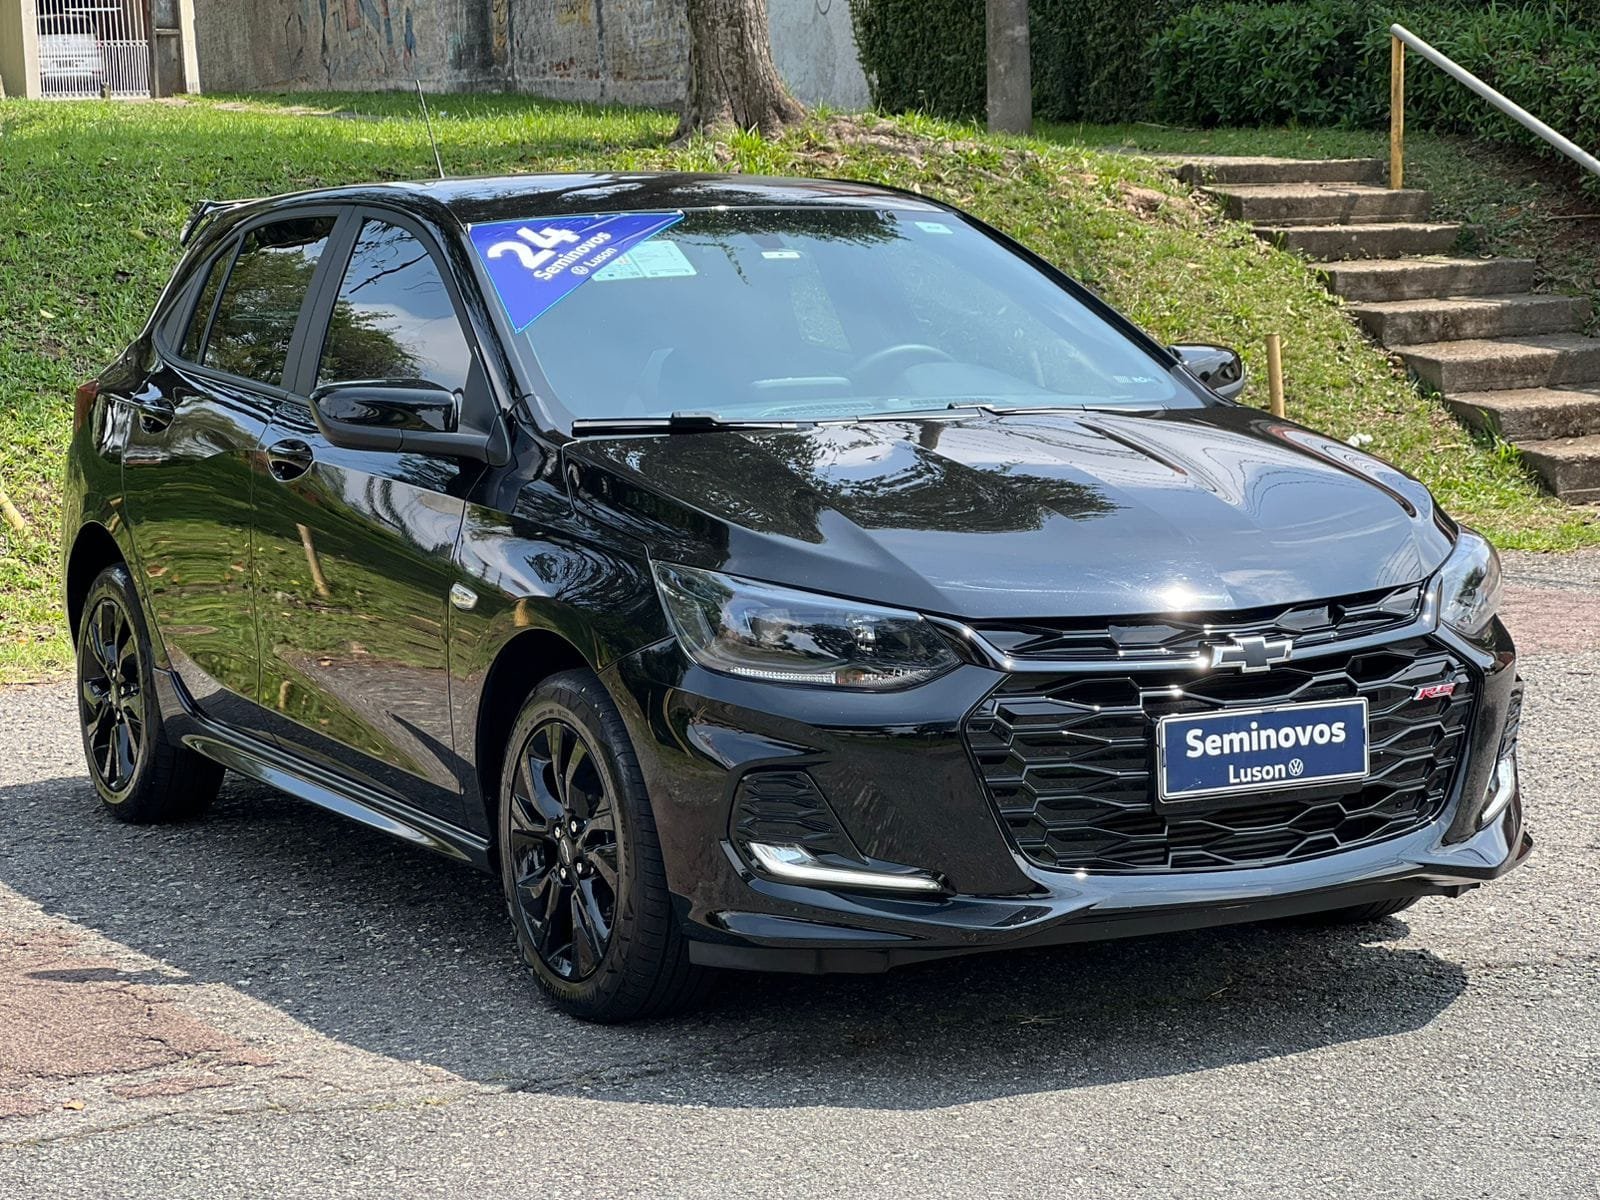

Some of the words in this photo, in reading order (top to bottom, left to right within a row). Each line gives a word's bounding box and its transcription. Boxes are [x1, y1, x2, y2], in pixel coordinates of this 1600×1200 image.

[487, 226, 581, 270] 24
[533, 231, 612, 281] Seminovos
[586, 247, 618, 268] Luson
[1414, 683, 1456, 701] RS
[1185, 721, 1347, 758] Seminovos
[1229, 763, 1286, 784] Luson
